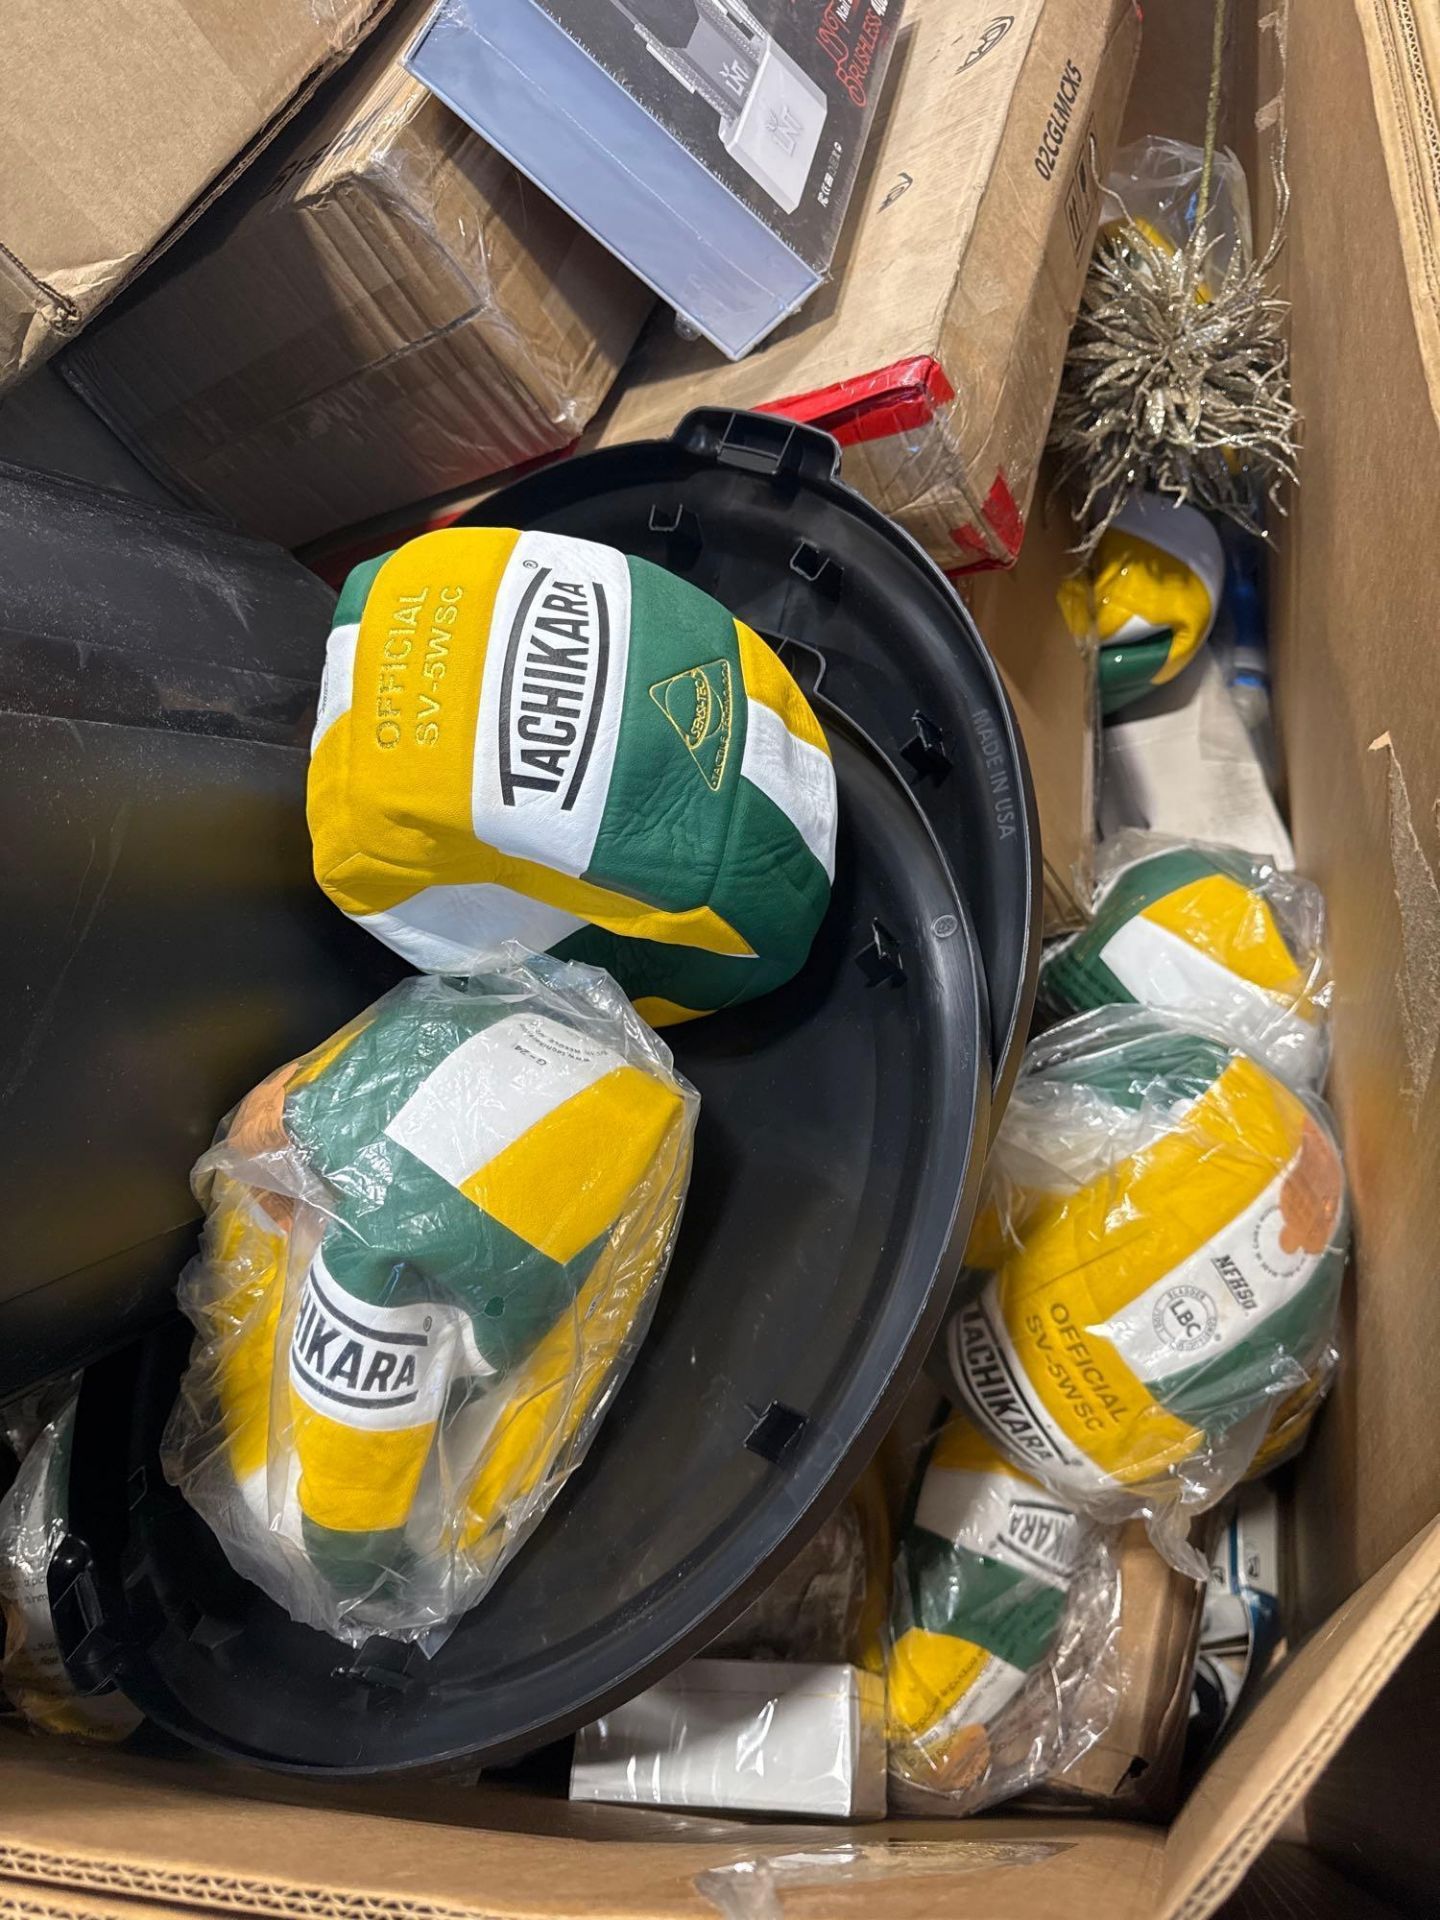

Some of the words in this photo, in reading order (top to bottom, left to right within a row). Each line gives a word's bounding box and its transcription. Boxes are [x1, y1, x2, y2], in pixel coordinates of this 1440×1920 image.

[835, 8, 882, 107] BRUSHLESS
[376, 586, 430, 750] OFFICIAL
[415, 585, 464, 747] SV-5WSC
[501, 580, 588, 806] TACHIKARA
[971, 709, 1001, 769] MADE
[989, 770, 1010, 794] IN
[994, 796, 1017, 841] USA
[1025, 1315, 1105, 1431] SV-5WSC
[1050, 1302, 1132, 1424] OFFICIAL
[1168, 1299, 1201, 1339] LBC
[961, 1305, 1055, 1463] TACHIKARA
